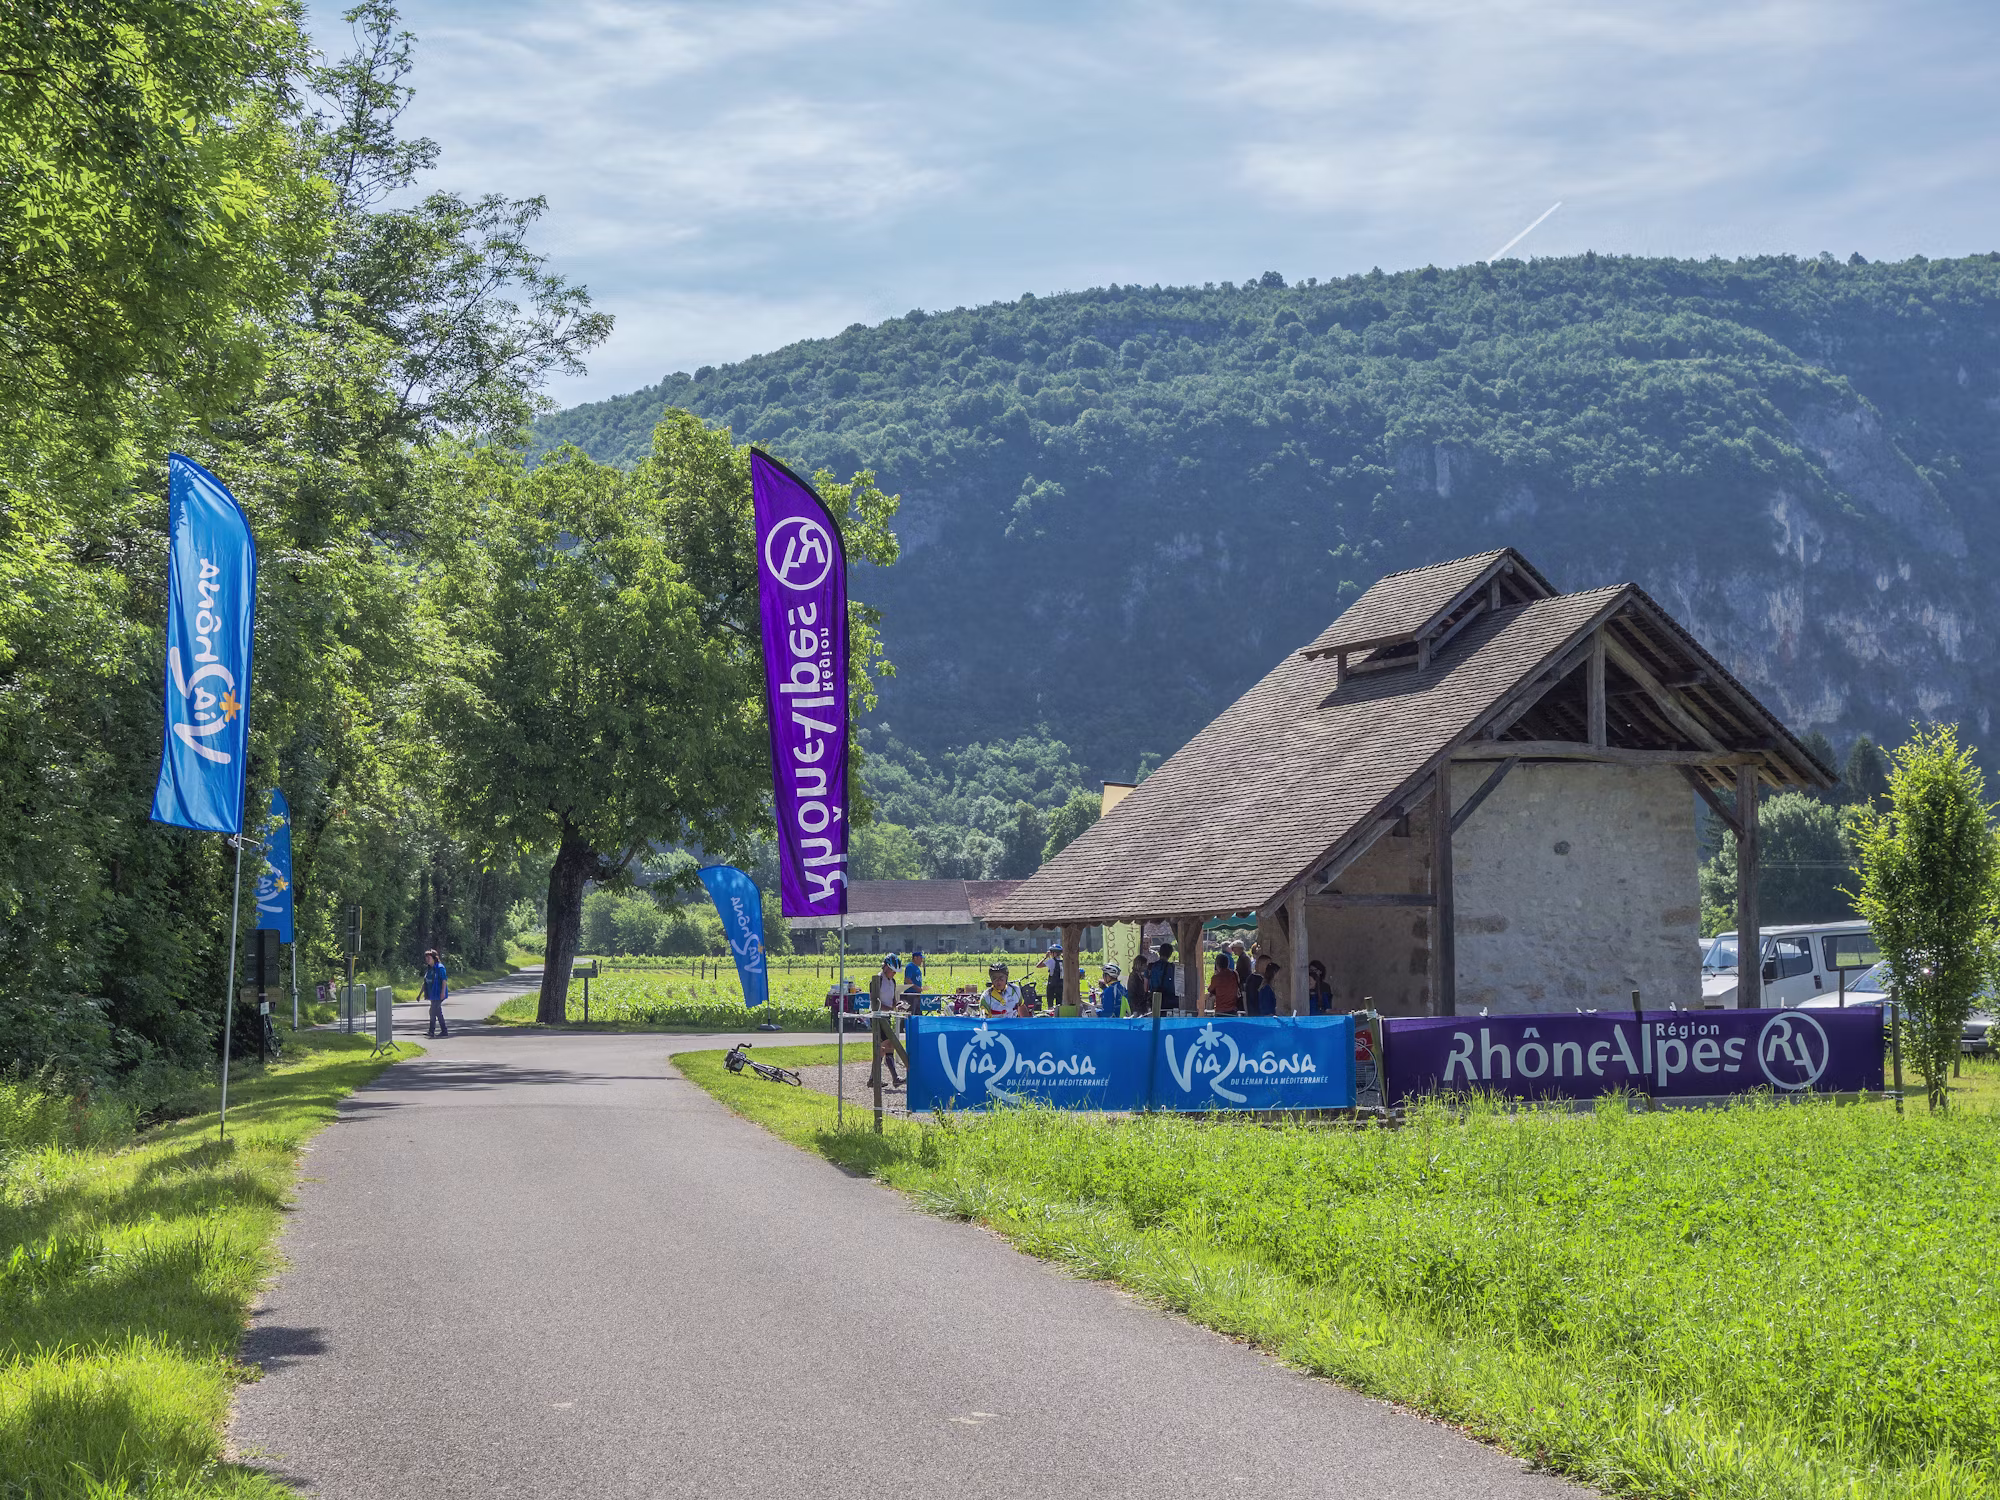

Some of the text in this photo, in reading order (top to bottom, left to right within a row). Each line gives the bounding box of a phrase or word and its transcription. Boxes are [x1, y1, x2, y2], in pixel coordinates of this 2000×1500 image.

[1656, 1022, 1720, 1039] Région
[1006, 1078, 1016, 1086] DU
[1018, 1077, 1041, 1086] LÉMAN
[1042, 1077, 1047, 1086] À
[1058, 1077, 1109, 1087] MÉDITERRANÉE
[1230, 1075, 1328, 1086] DU LÉMAN À LA MÉDITERRANÉE
